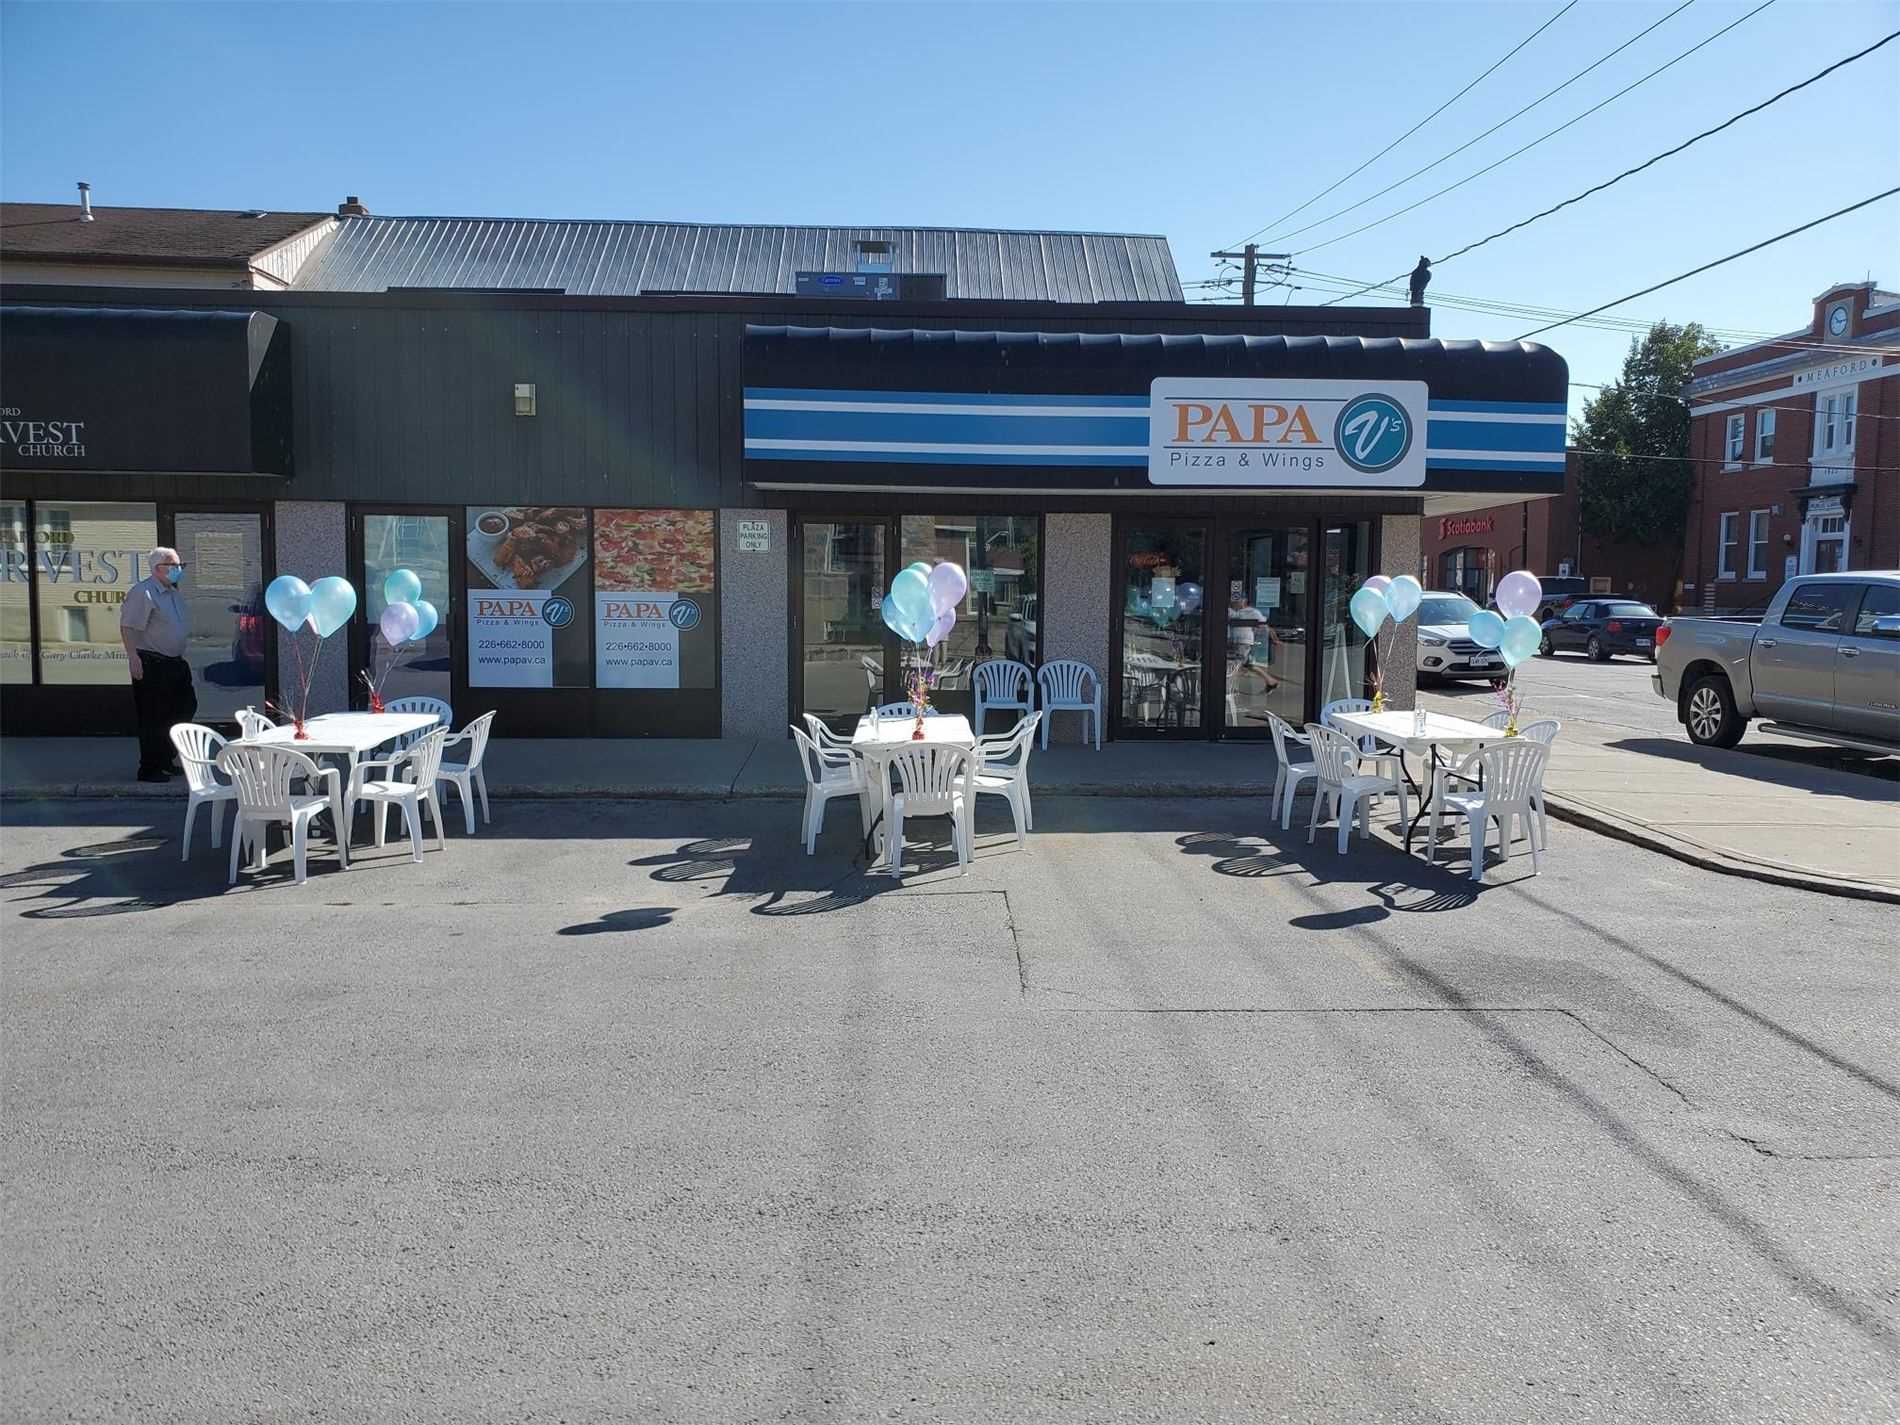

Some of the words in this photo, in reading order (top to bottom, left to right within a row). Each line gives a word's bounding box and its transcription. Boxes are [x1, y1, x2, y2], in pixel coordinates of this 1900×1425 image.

[1807, 361, 1867, 382] MEAFORD
[1171, 403, 1323, 444] PAPA
[0, 421, 85, 445] VEST
[18, 444, 86, 457] CHURCH
[1170, 451, 1226, 467] Pizza
[1238, 452, 1250, 467] &
[1262, 452, 1325, 471] Wings
[742, 523, 765, 531] PLAZA
[1446, 514, 1496, 536] Scotiabank
[740, 532, 768, 540] PARKING
[745, 541, 762, 549] ONLY
[74, 590, 127, 604] CHUR
[477, 600, 538, 617] PAPA
[605, 602, 666, 619] PAPA
[476, 619, 500, 627] Pizza
[513, 619, 540, 628] Wings
[640, 621, 667, 630] Wings
[478, 656, 546, 666] www.papav.ca
[605, 659, 673, 668] www.papav.ca
